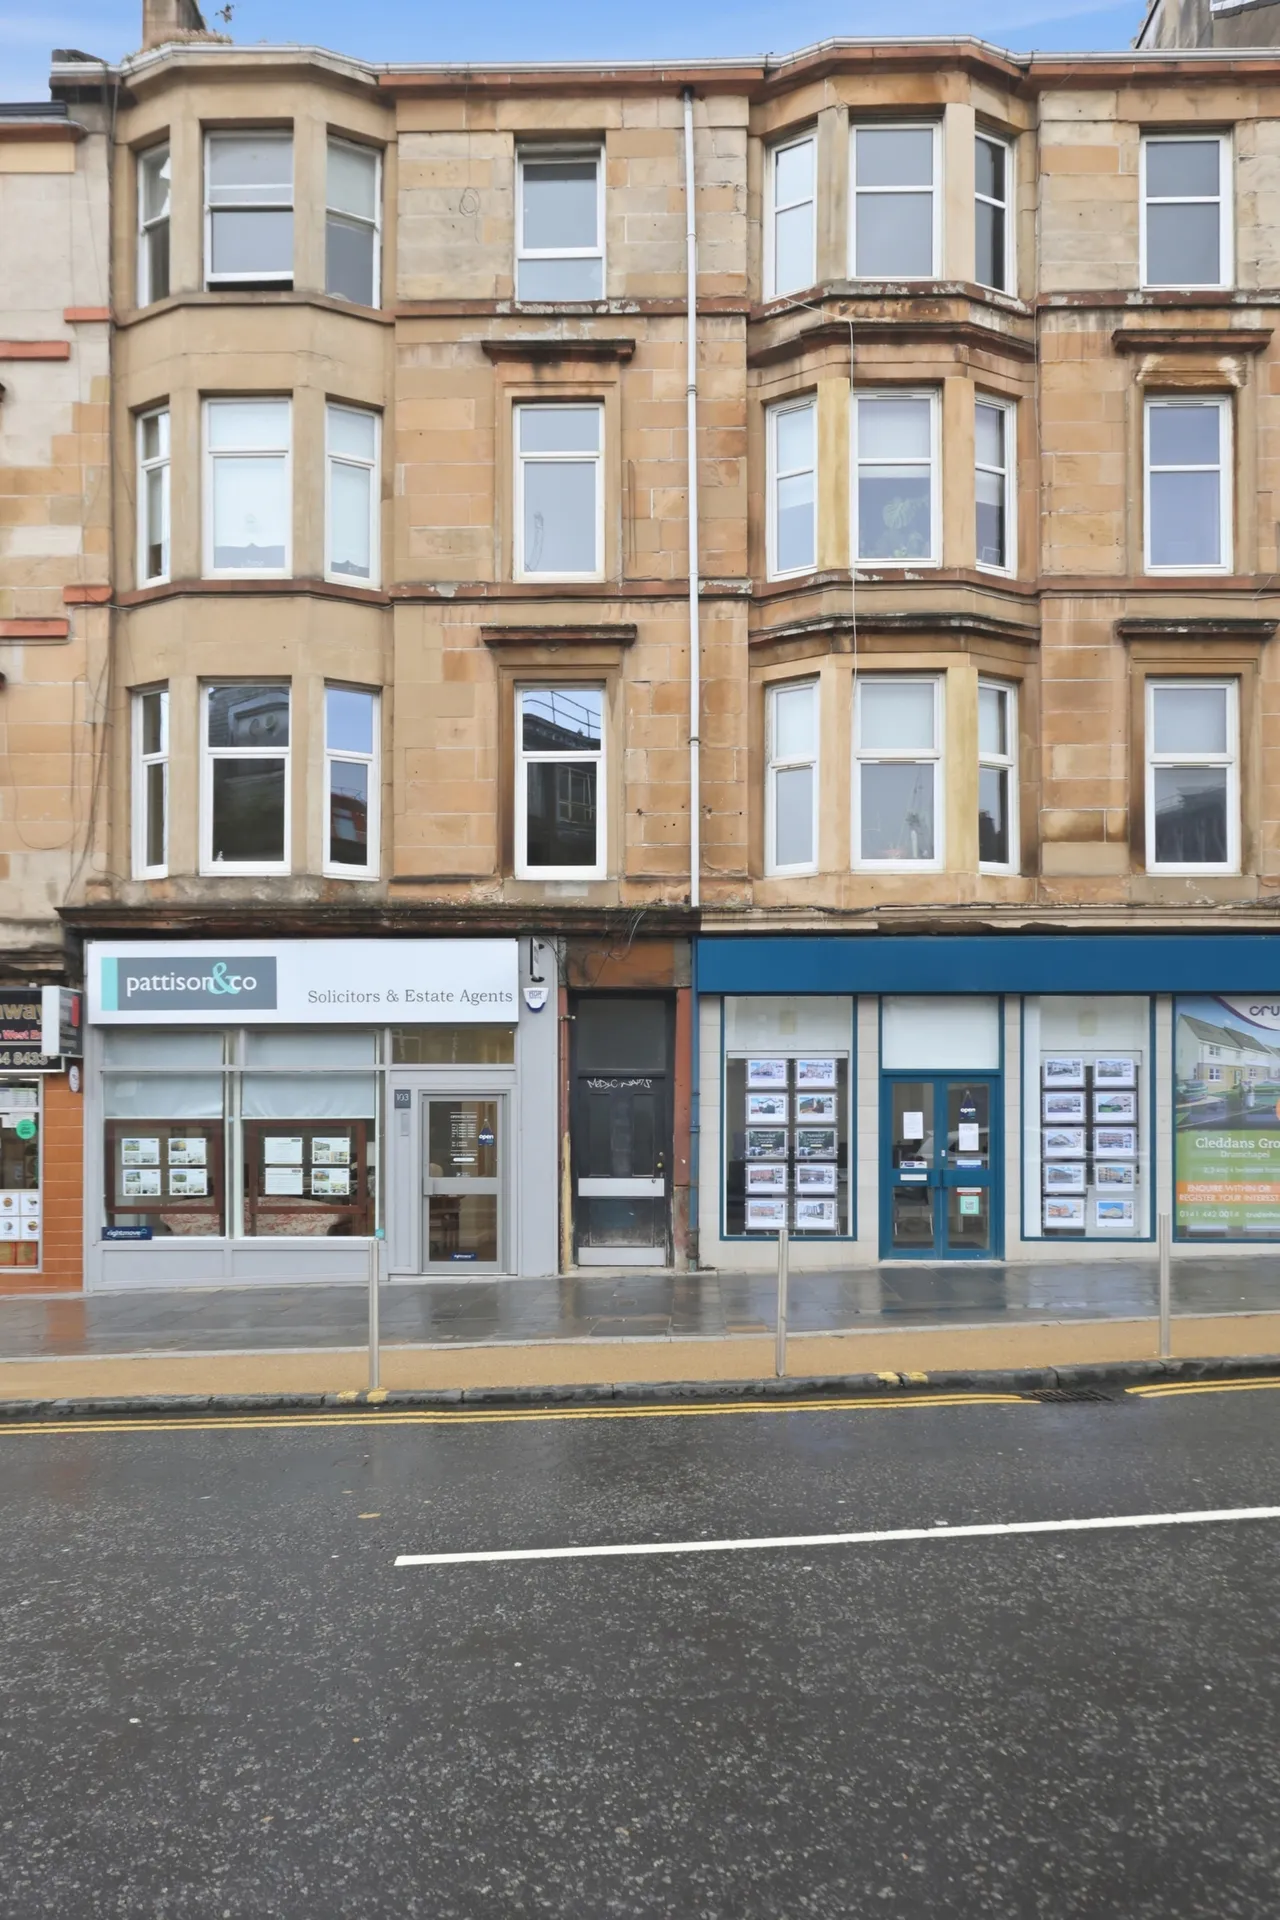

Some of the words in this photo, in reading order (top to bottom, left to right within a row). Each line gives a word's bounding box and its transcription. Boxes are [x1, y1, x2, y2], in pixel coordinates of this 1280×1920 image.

[307, 989, 381, 1004] Solicitors
[386, 990, 399, 1003] &
[405, 989, 455, 1003] Estate
[459, 989, 513, 1006] Agents
[395, 1093, 409, 1102] 103
[1195, 1137, 1255, 1149] Cleddans
[1220, 1150, 1270, 1159] Drumchapel
[1224, 1184, 1256, 1192] WITHIN
[106, 1229, 141, 1237] rightmove
